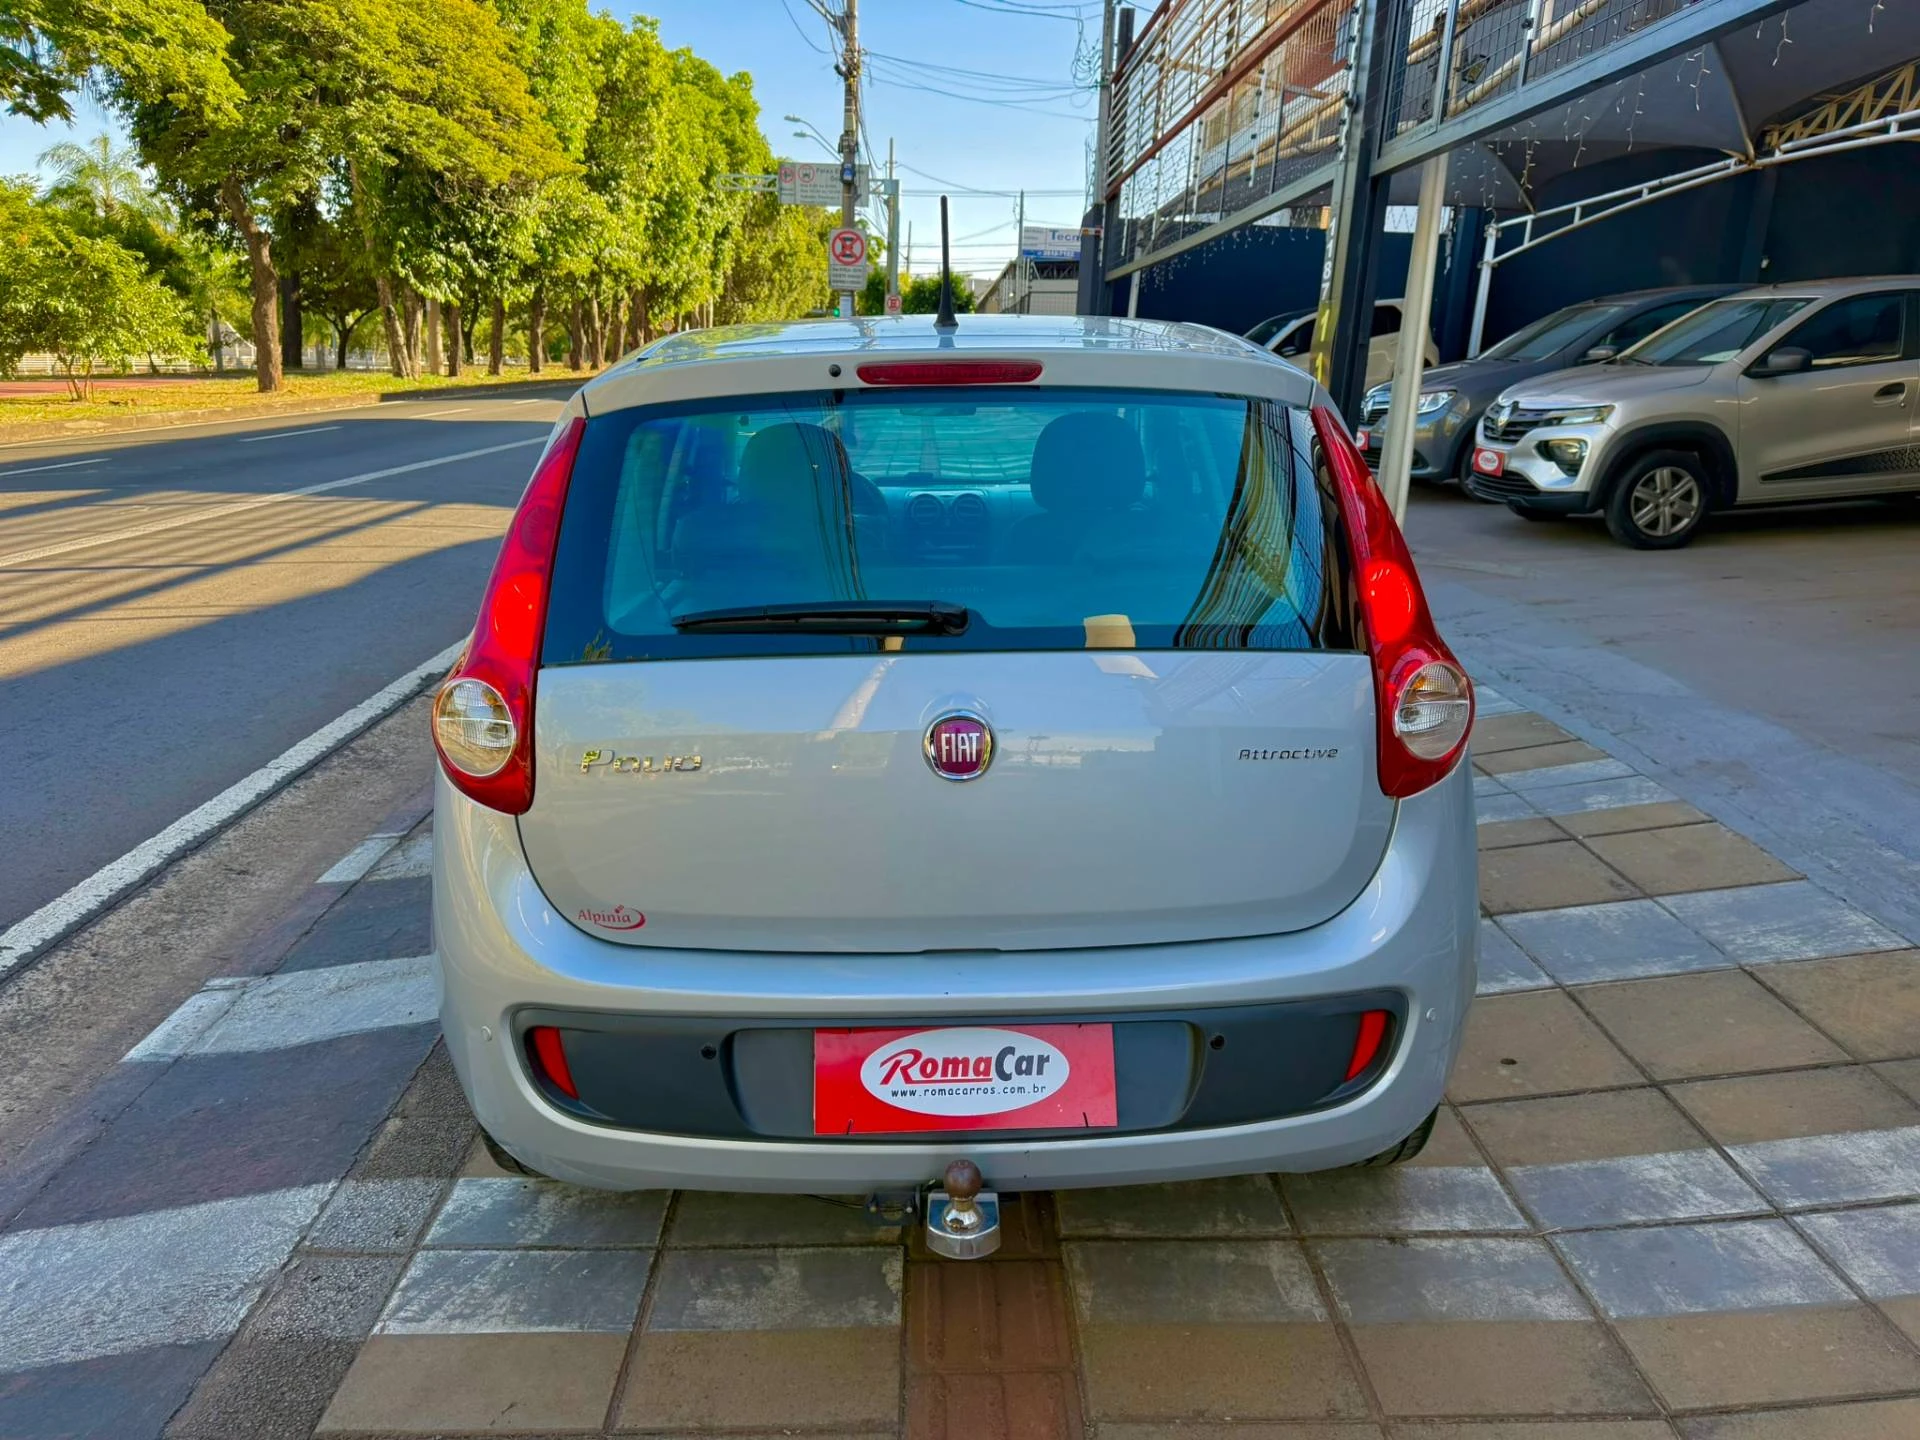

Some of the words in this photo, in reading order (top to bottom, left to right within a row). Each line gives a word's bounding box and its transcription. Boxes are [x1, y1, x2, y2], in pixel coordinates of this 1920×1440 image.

[1321, 217, 1336, 301] 1187
[941, 732, 980, 762] FIAT
[1239, 748, 1339, 760] Attractive
[578, 908, 631, 925] Alpinia
[879, 1045, 1050, 1085] RomaCar
[891, 1083, 1047, 1098] www.romacarros.com.br
